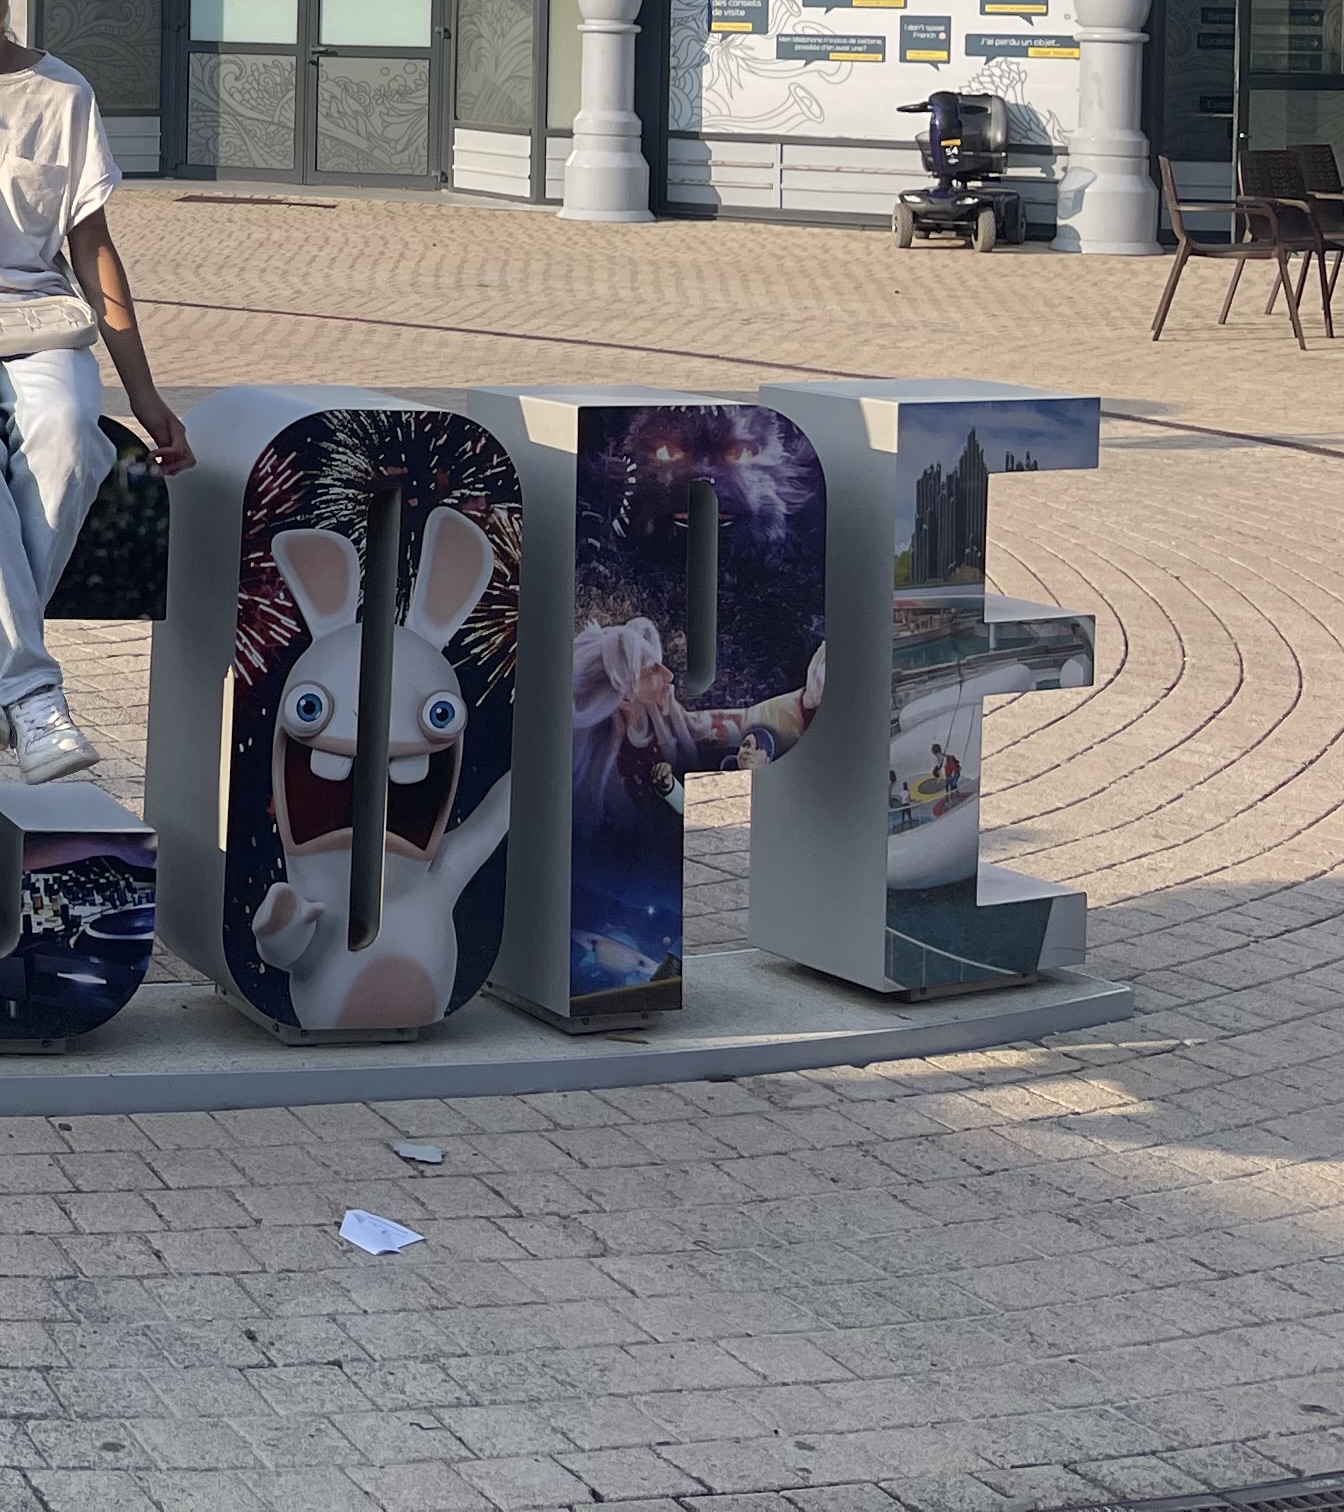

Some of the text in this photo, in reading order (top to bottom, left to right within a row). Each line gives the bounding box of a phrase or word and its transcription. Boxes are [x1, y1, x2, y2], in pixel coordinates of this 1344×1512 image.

[712, 0, 727, 7] des
[712, 8, 722, 16] de
[979, 37, 994, 45] J'ai
[994, 38, 1020, 47] perdu
